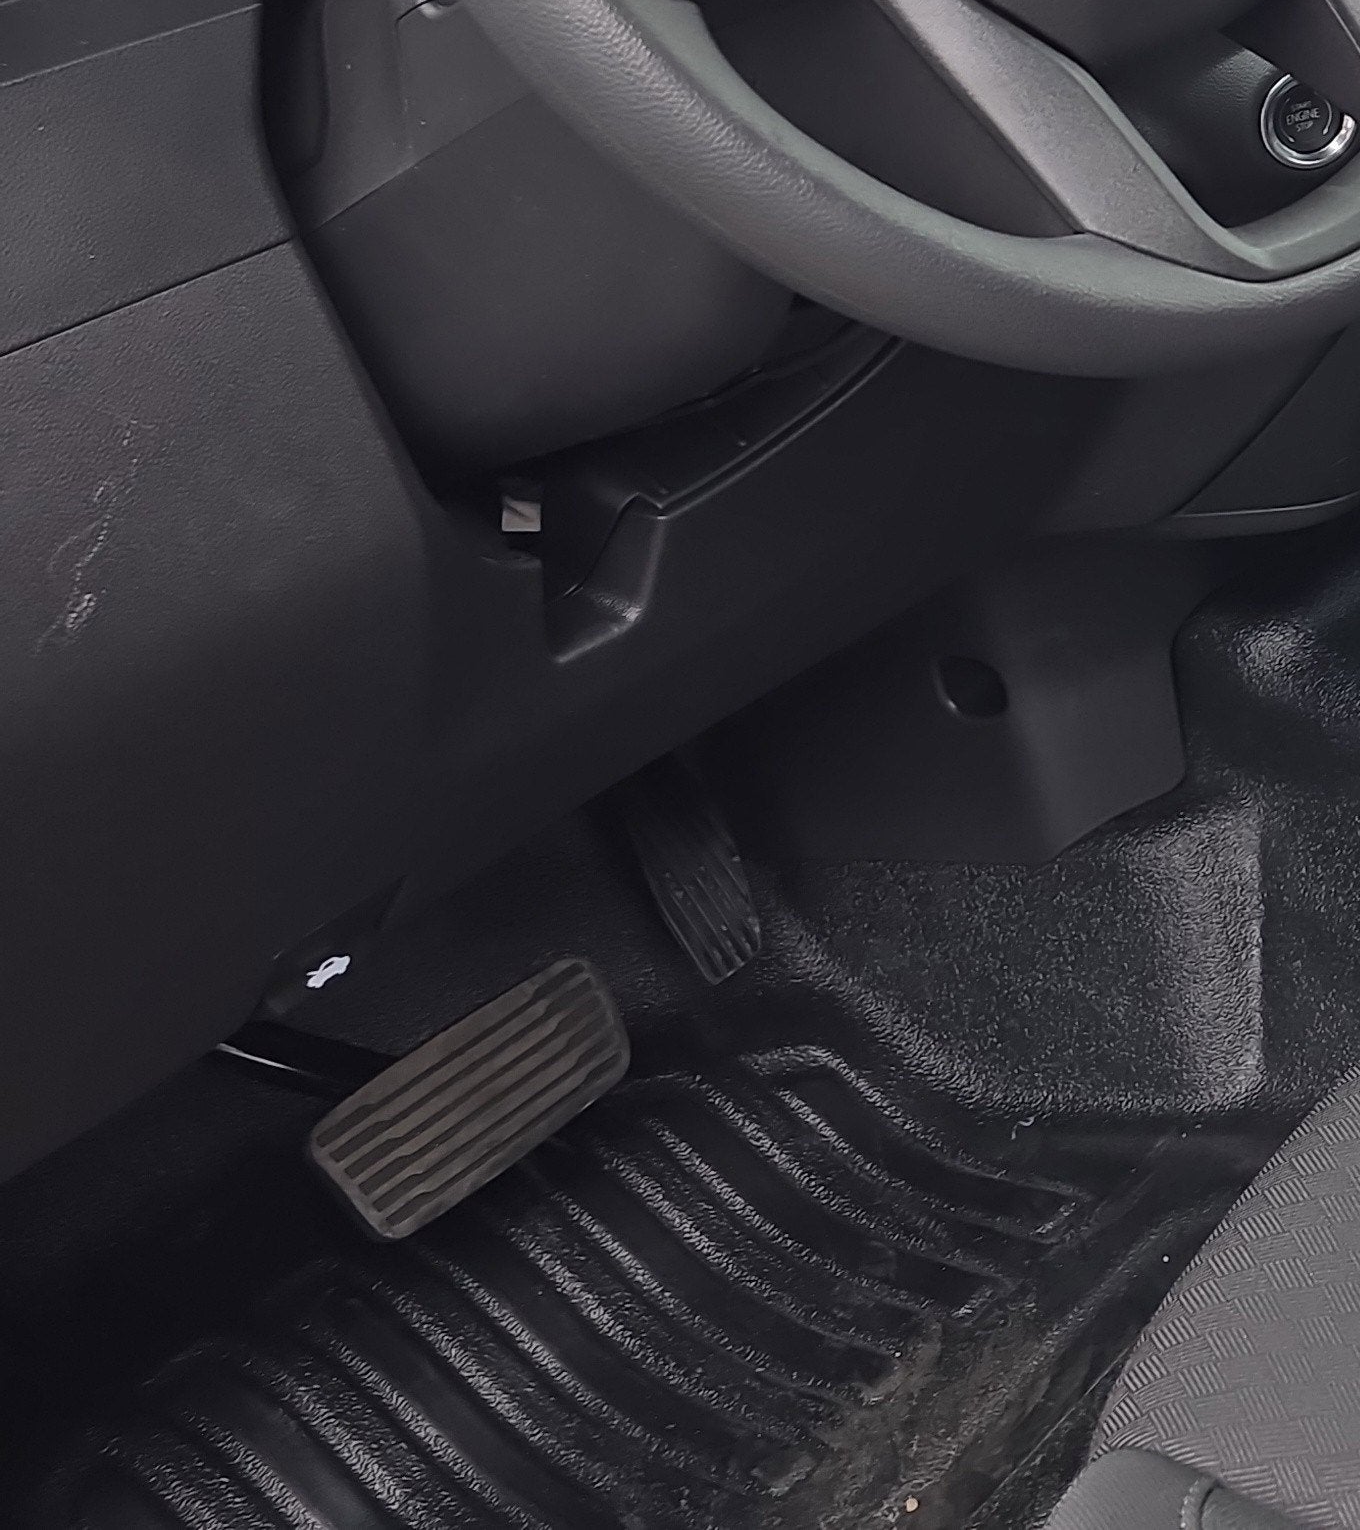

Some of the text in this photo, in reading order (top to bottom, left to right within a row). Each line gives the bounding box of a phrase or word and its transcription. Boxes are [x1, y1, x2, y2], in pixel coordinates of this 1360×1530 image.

[1291, 100, 1312, 112] START
[1285, 107, 1321, 125] ENGINE
[1296, 120, 1313, 132] STOP
